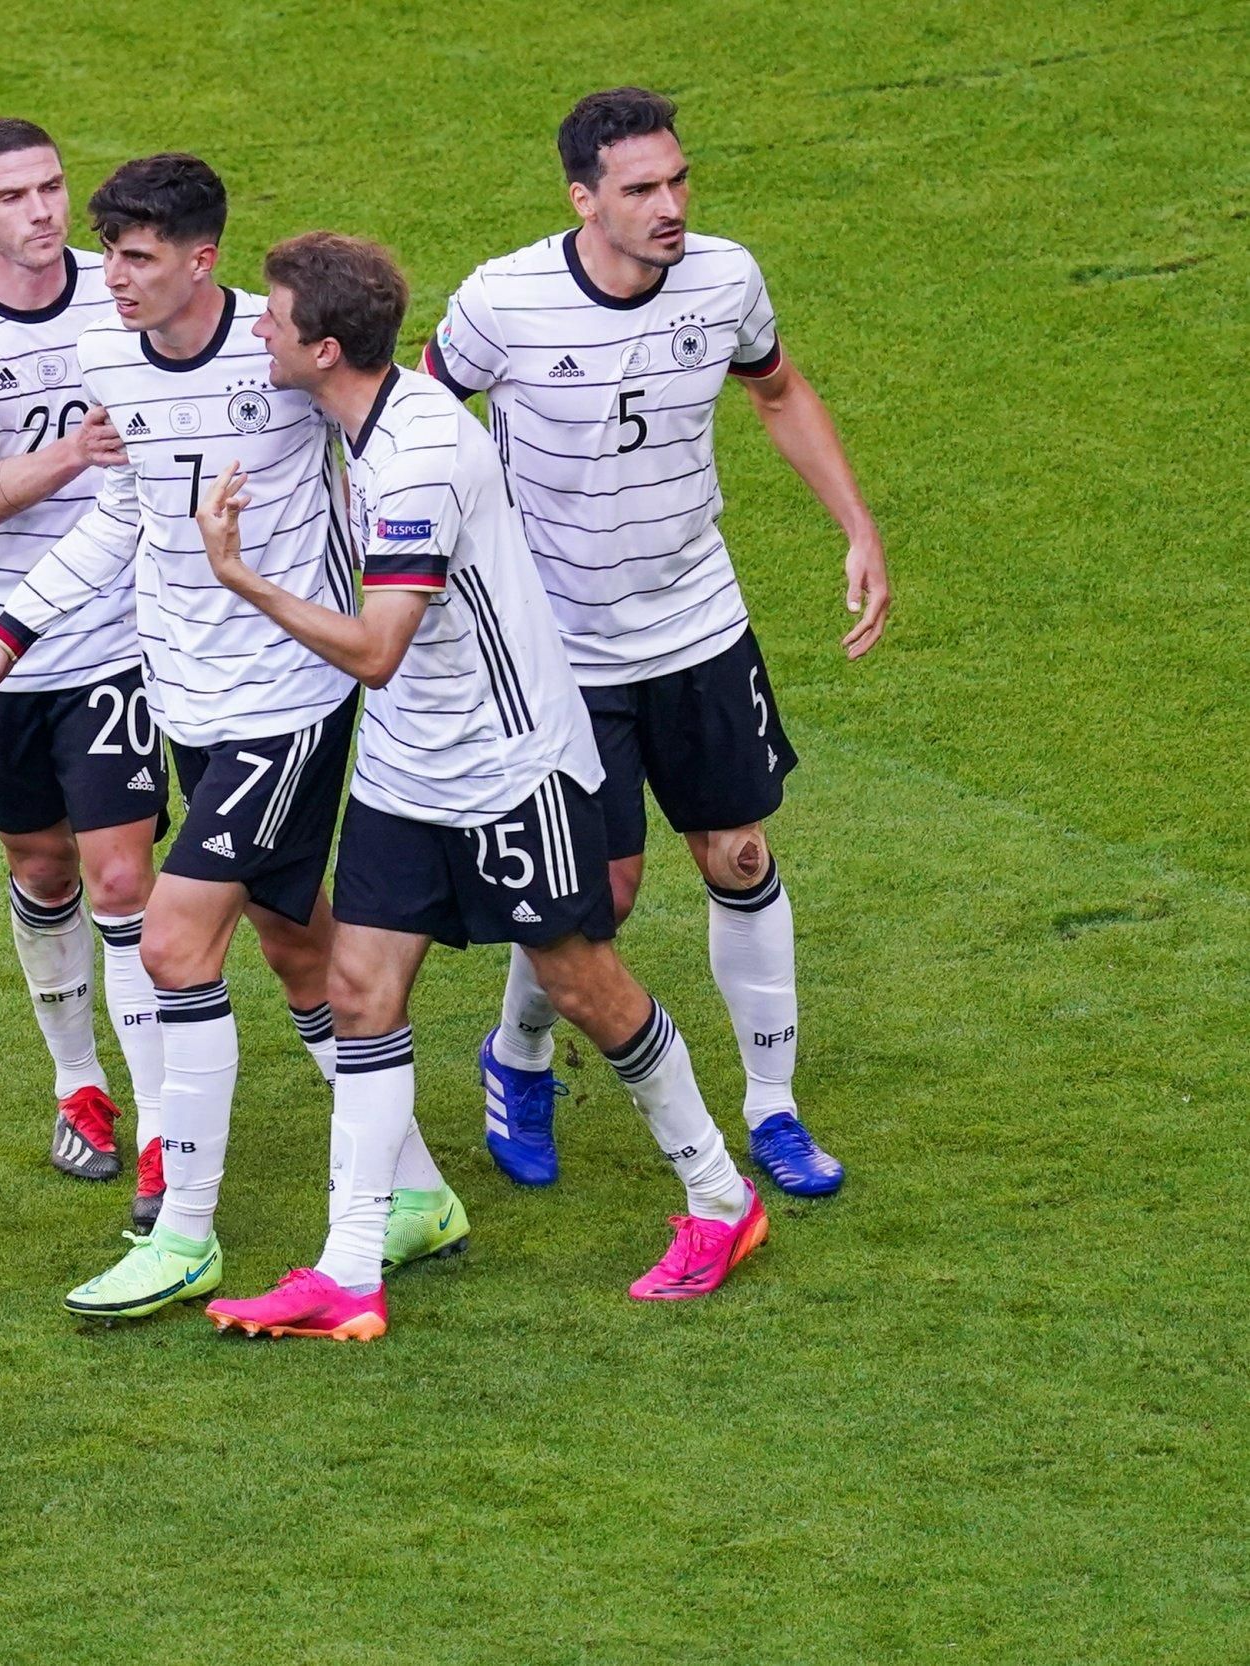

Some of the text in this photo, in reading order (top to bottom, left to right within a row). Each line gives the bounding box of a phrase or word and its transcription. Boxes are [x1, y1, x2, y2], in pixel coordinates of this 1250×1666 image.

[549, 369, 586, 378] adidas
[126, 426, 151, 436] adidas
[617, 389, 648, 454] 5
[173, 453, 203, 518] 7
[386, 524, 430, 536] RESPECT
[750, 665, 768, 737] 5
[87, 684, 156, 756] 20
[127, 780, 156, 792] adidas
[215, 751, 274, 816] 7
[202, 840, 237, 859] adidas
[464, 822, 535, 890] 25
[39, 983, 88, 1003] DFB
[754, 1025, 795, 1049] DFB
[661, 1145, 698, 1163] FB
